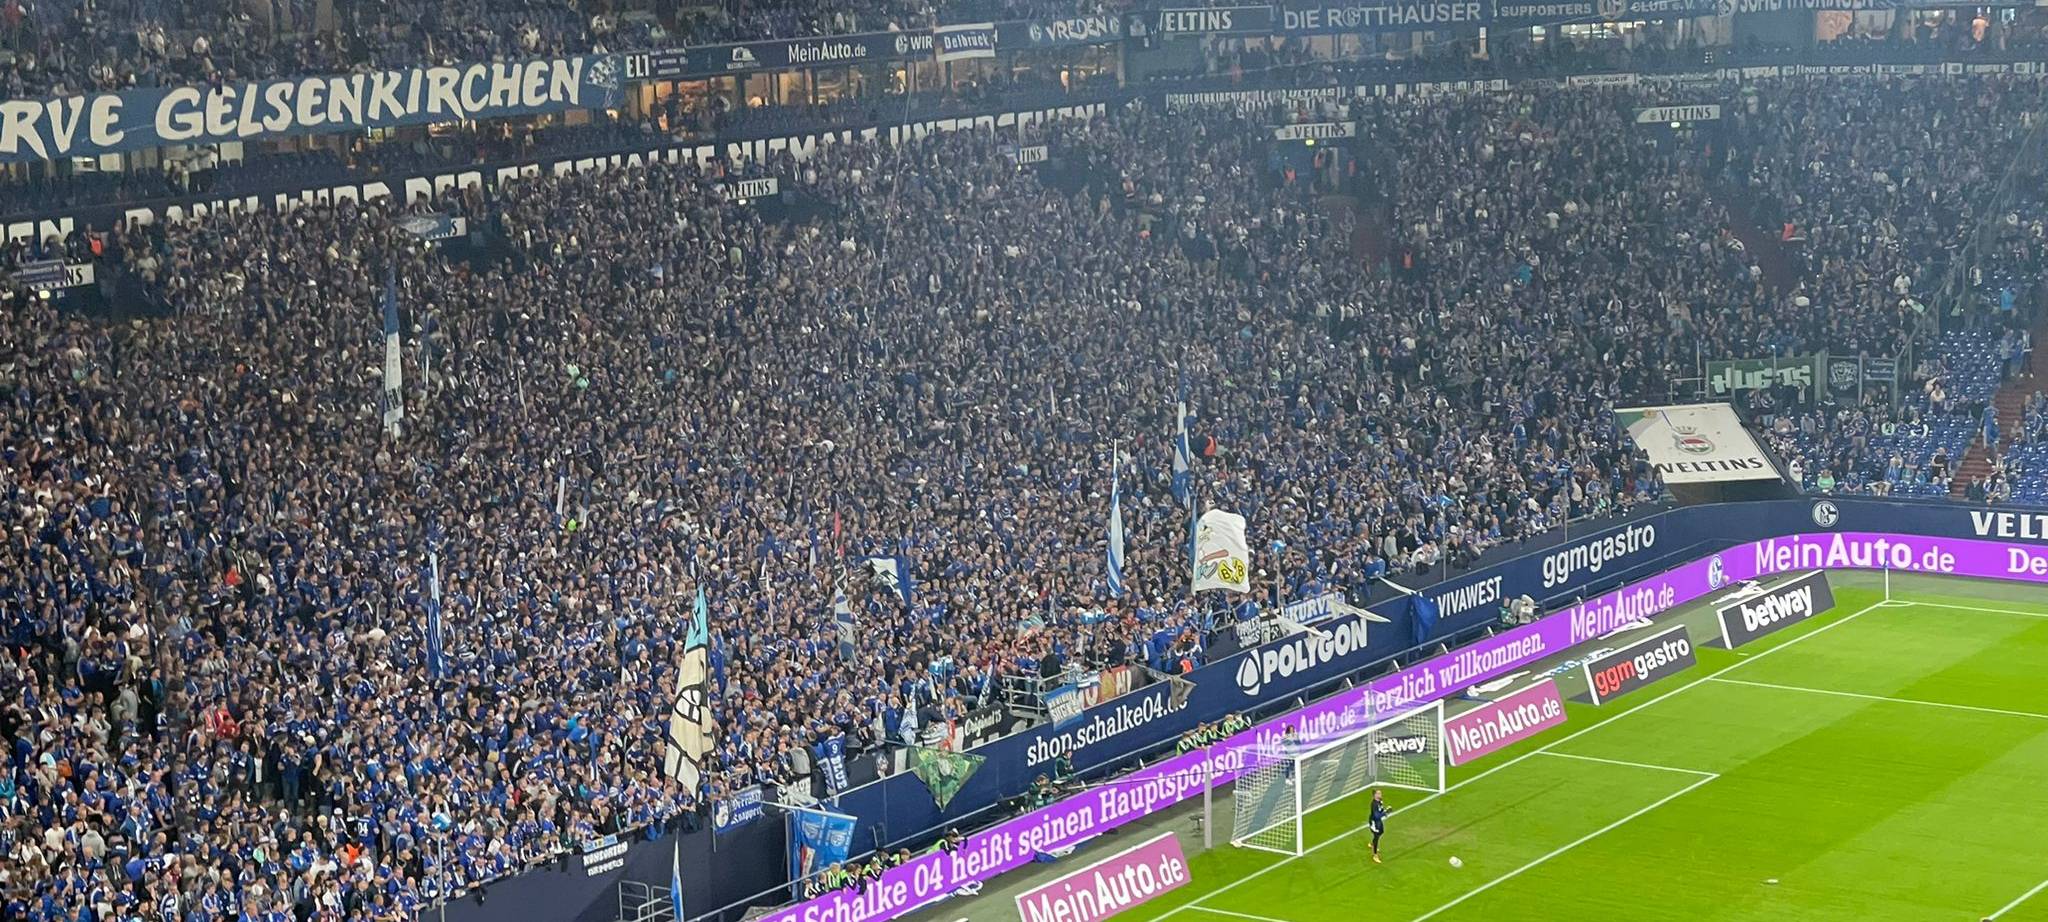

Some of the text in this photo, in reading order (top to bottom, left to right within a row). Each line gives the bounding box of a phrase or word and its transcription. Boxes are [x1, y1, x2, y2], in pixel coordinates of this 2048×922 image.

[1285, 10, 1320, 29] DIE
[1501, 3, 1592, 17] SUPPORTERS
[911, 35, 932, 50] WIR
[1046, 16, 1107, 41] VREDEN
[788, 41, 867, 63] MeinAuto.de
[155, 57, 584, 141] GELSENKIRCHEN
[1660, 107, 1711, 121] VELTINS
[1293, 124, 1346, 138] VELTINS
[1655, 456, 1764, 474] VELTINS
[1970, 511, 2048, 540] VELT
[1543, 525, 1655, 588] ggmgastro
[1755, 533, 1955, 574] MeinAuto.de
[2007, 547, 2048, 575] De
[1437, 576, 1502, 618] VIVAWEST
[1571, 582, 1674, 643] MeinAuto.de
[1741, 584, 1812, 632] betway
[1263, 621, 1367, 684] POLYGON
[1595, 637, 1690, 696] ggmgastro
[1450, 697, 1561, 757] MeinAuto.de
[1374, 736, 1426, 754] etway
[914, 857, 943, 897] 04
[950, 832, 1013, 884] heißt
[1018, 805, 1094, 857] seinen
[1099, 749, 1245, 814] Hauptsponsor
[1256, 705, 1356, 762] MeAuto.de
[1439, 631, 1546, 690] willkommen.
[1028, 856, 1184, 922] MeinAuto.de
